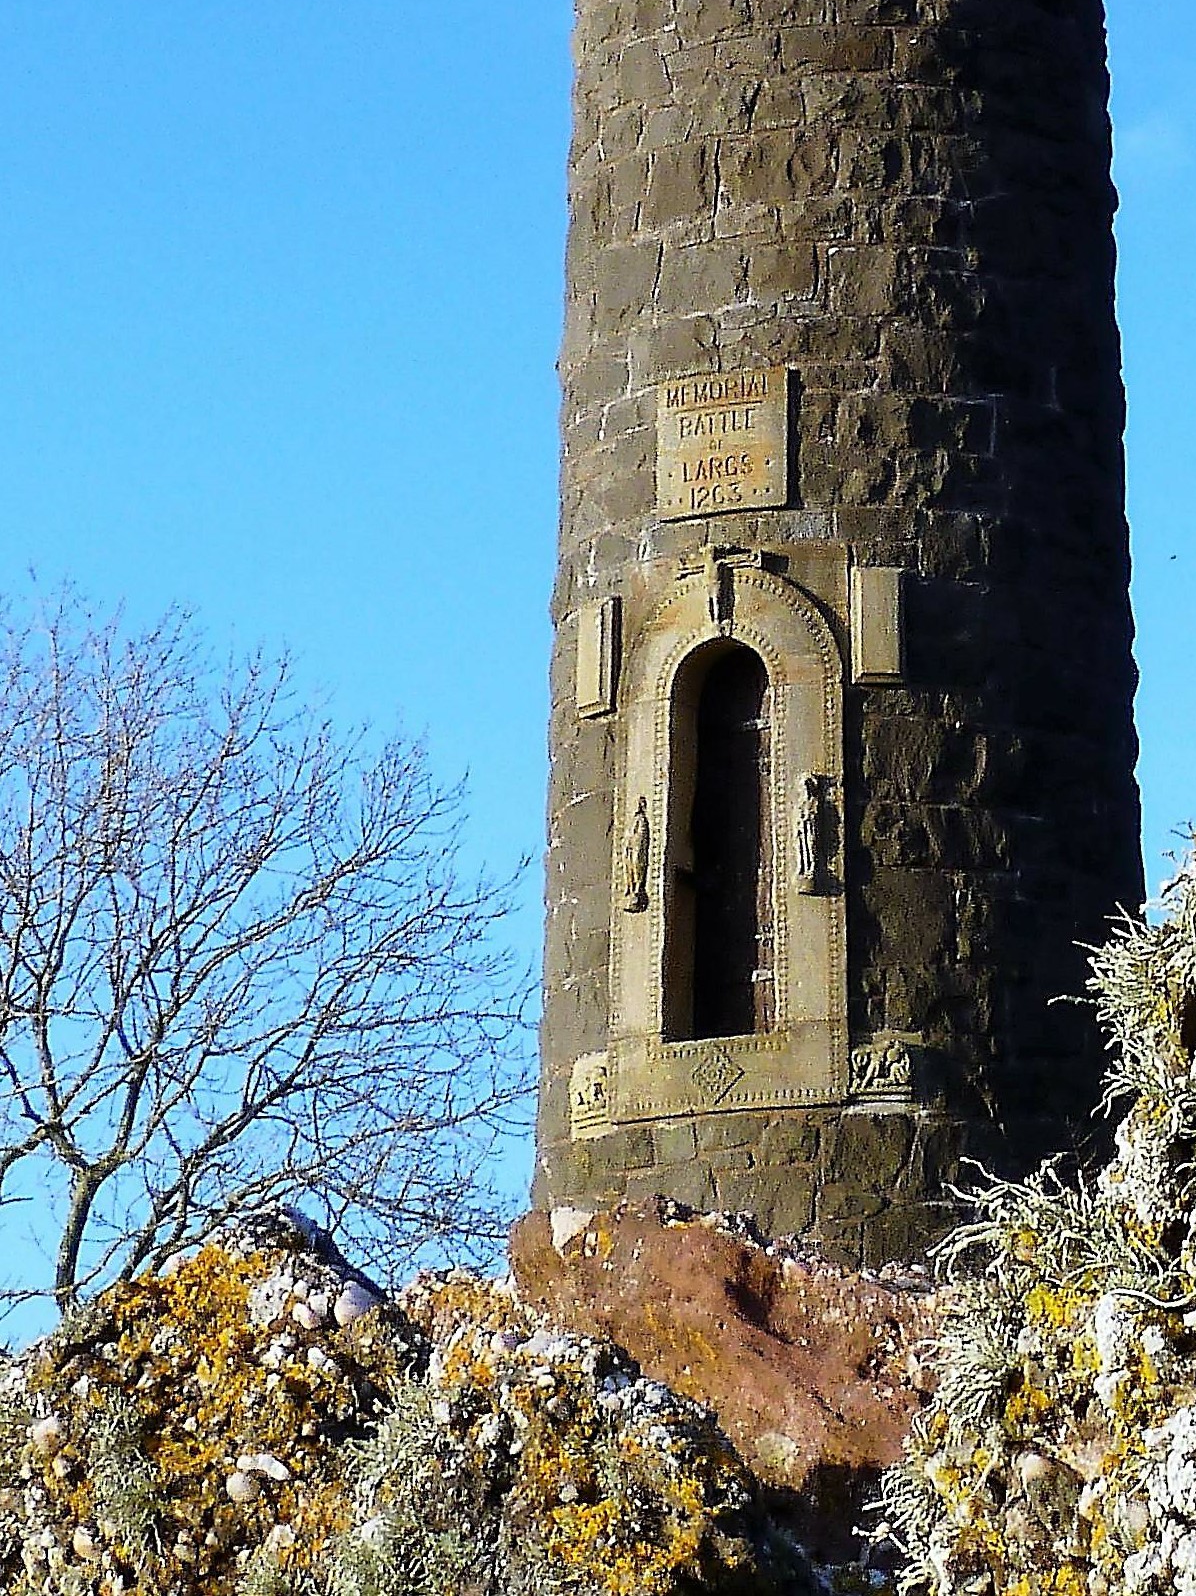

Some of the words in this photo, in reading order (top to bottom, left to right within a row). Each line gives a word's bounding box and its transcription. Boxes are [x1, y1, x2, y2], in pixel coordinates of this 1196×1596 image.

[666, 374, 768, 408] MEMORIAL
[680, 408, 755, 438] BATTLE
[683, 454, 753, 483] LARGS
[691, 482, 743, 509] 1263
